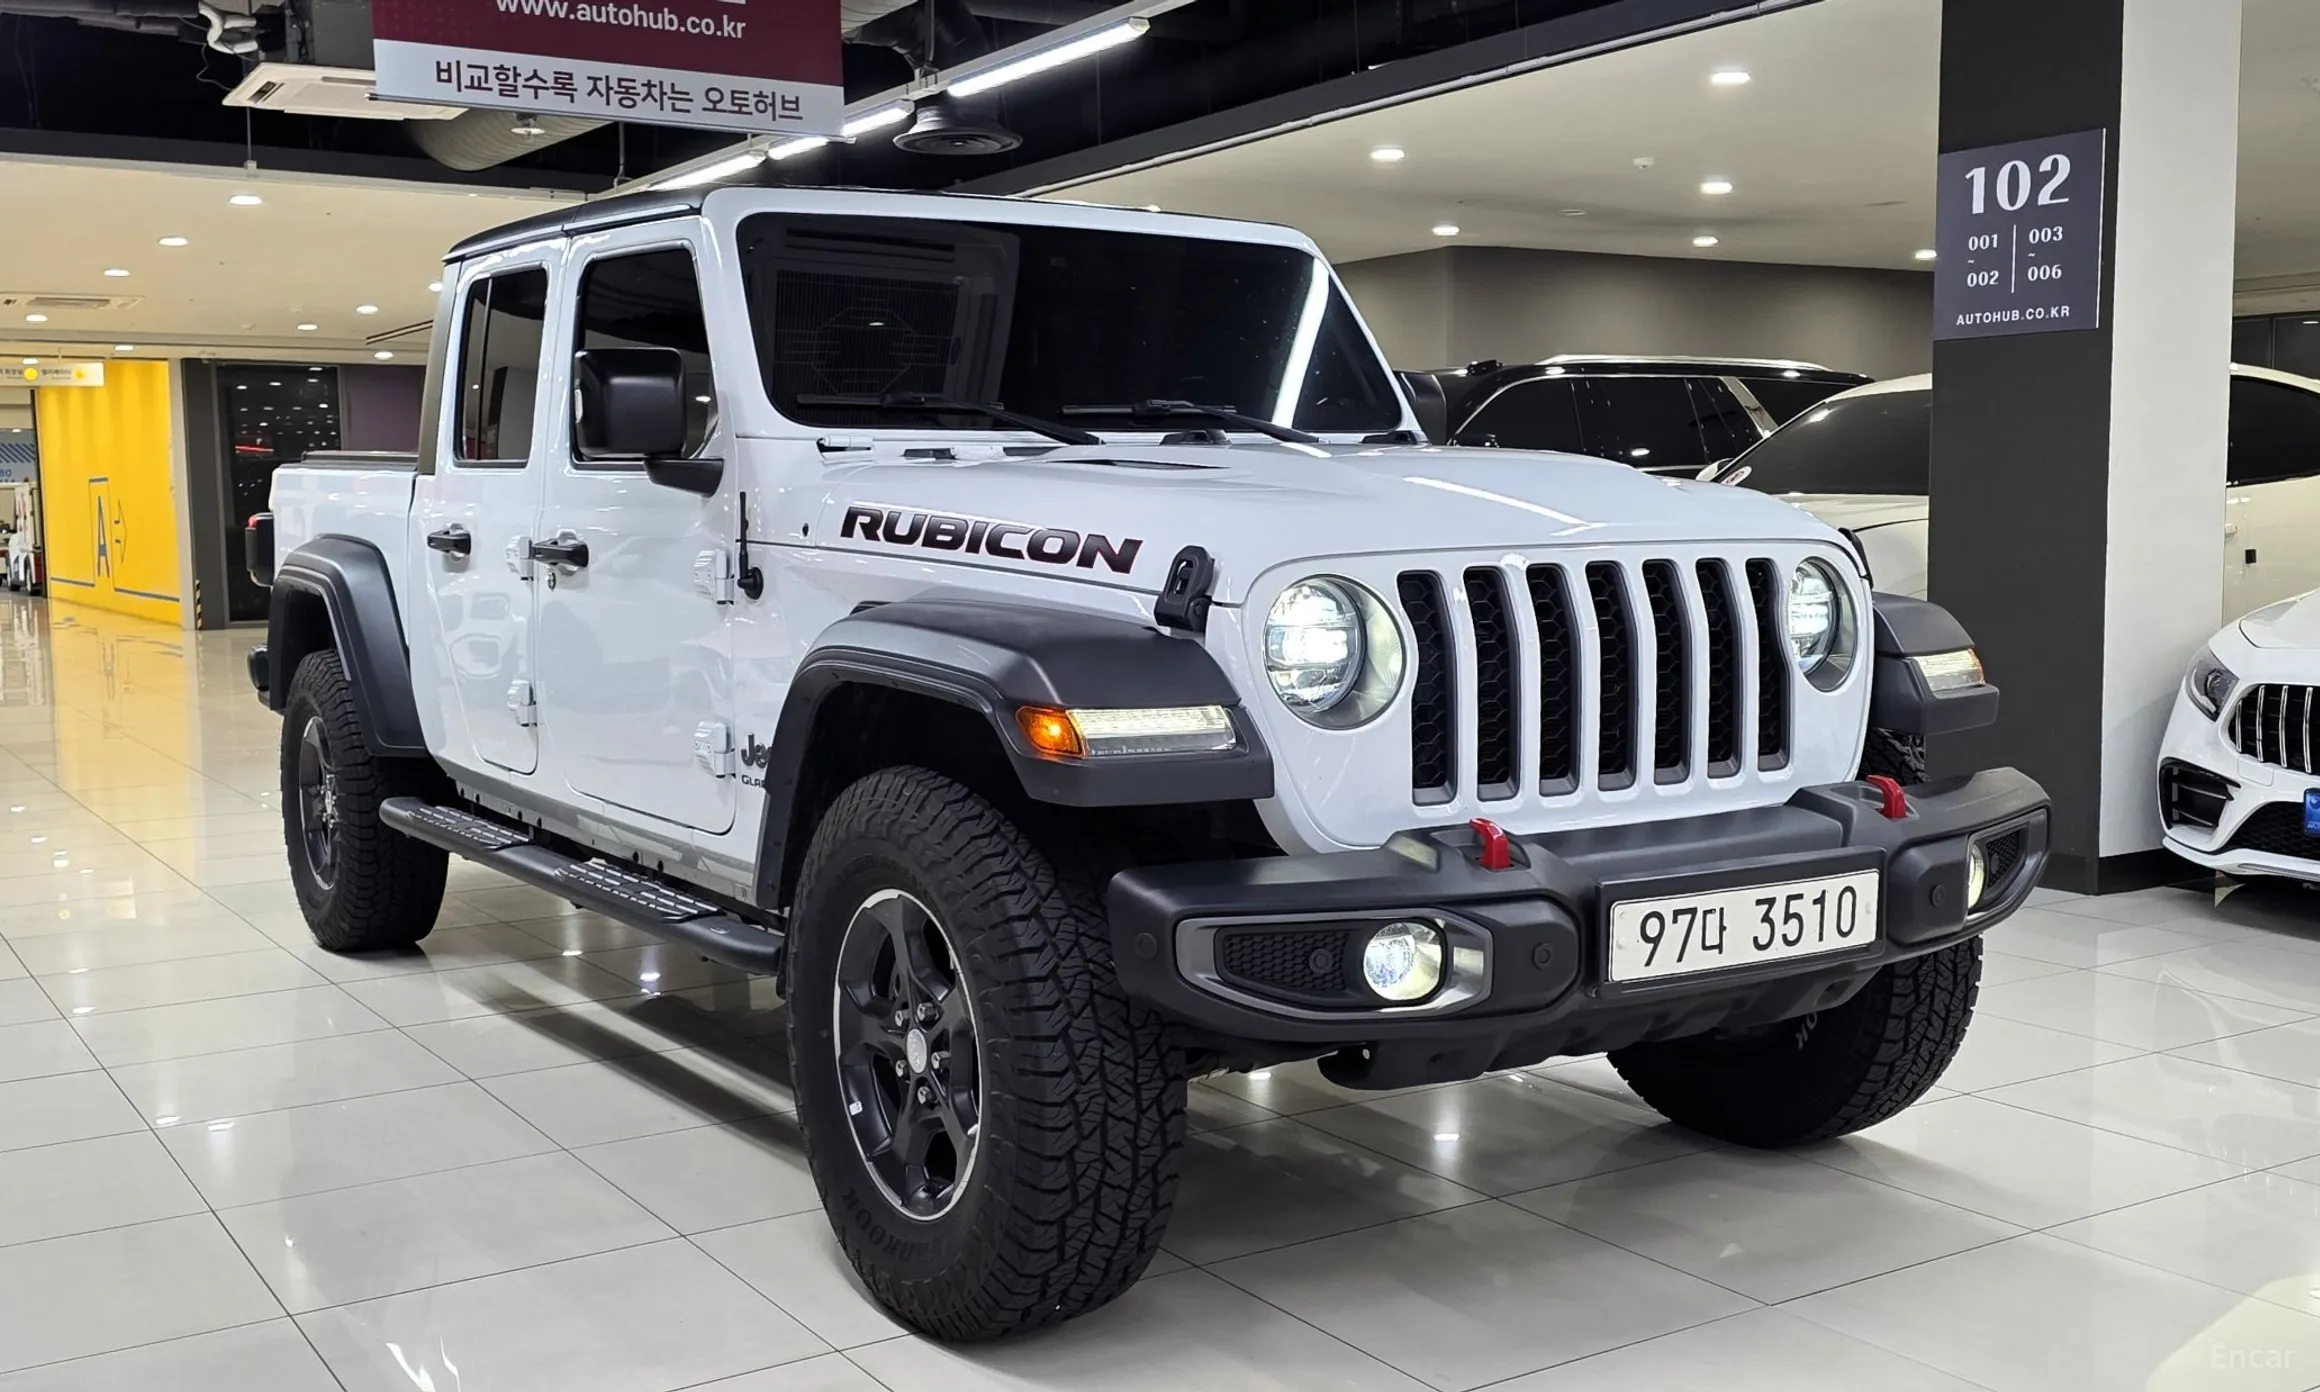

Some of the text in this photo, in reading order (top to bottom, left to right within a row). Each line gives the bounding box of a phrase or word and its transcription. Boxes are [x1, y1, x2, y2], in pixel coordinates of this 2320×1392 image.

[496, 0, 746, 39] www.autohub.co.kr
[435, 60, 804, 121] 비교할수록 자동차는 오토허브
[1965, 153, 2071, 215] 102
[1968, 234, 1999, 251] 001
[2028, 226, 2064, 244] 003
[1966, 270, 2000, 287] 002
[2027, 264, 2063, 282] 006
[1956, 305, 2071, 326] AUTOHUB.CO.KR
[840, 505, 1144, 575] RUBICON
[1640, 885, 1858, 967] 97다 3510
